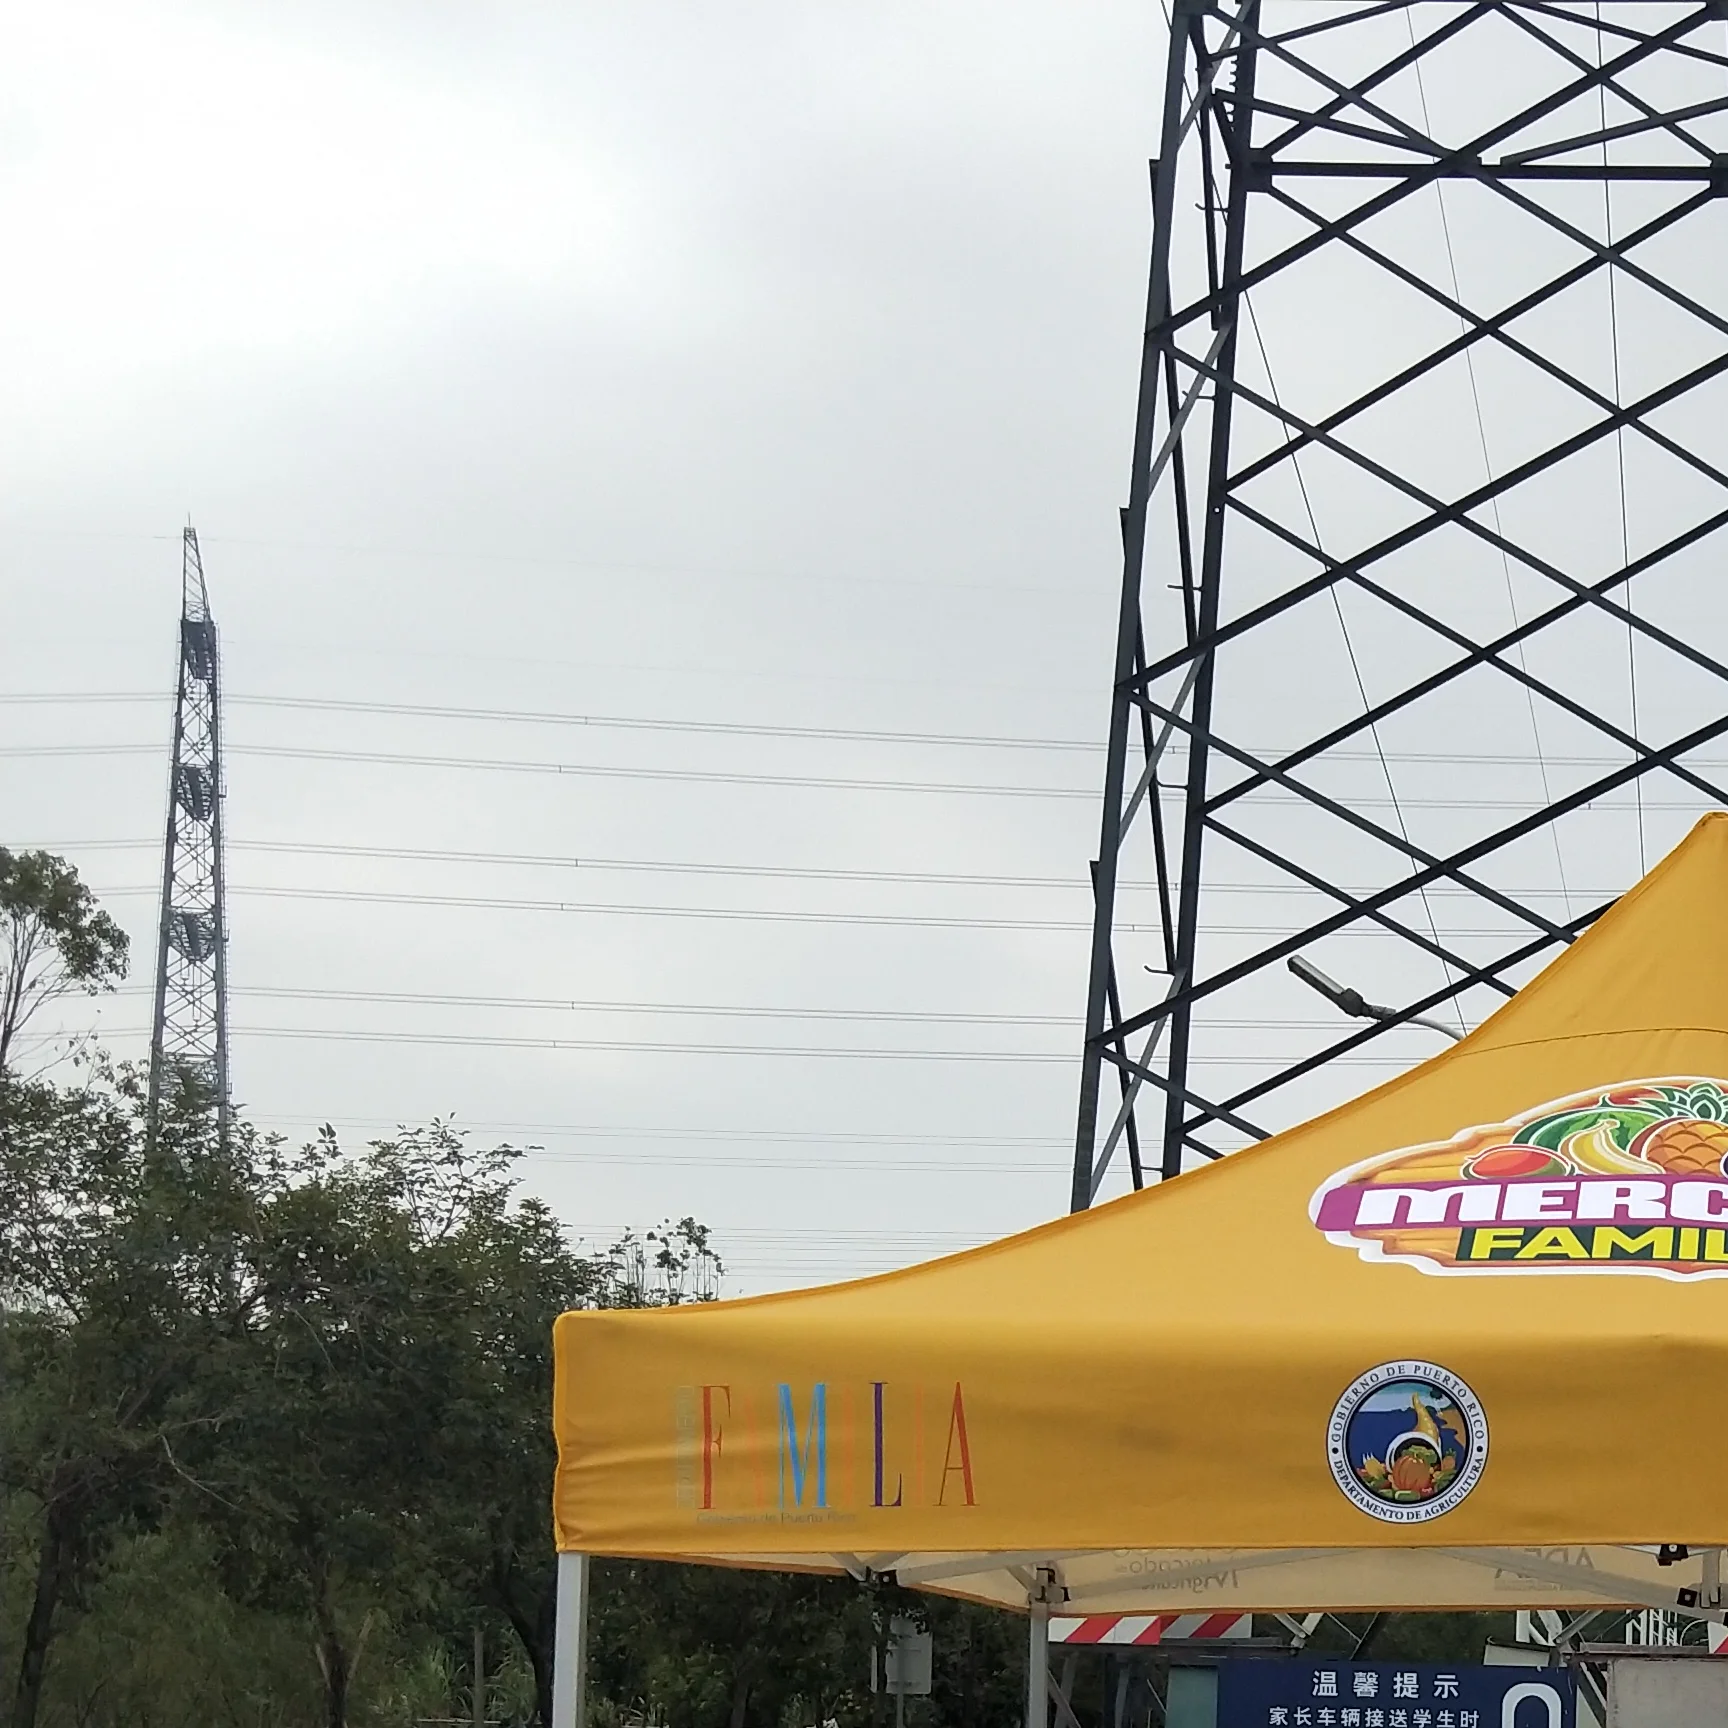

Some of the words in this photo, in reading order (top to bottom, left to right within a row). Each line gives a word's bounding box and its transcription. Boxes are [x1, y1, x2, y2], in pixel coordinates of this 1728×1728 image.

[1331, 1373, 1380, 1442] GOBIERNO
[1386, 1365, 1406, 1376] DE
[1414, 1364, 1467, 1398] PUERTO
[1467, 1402, 1485, 1440] RICO
[1333, 1460, 1404, 1520] DEPARTAMENTO
[1406, 1510, 1422, 1520] DE
[1424, 1457, 1484, 1518] AGRICULTURA
[1312, 1670, 1459, 1699] 温馨提示
